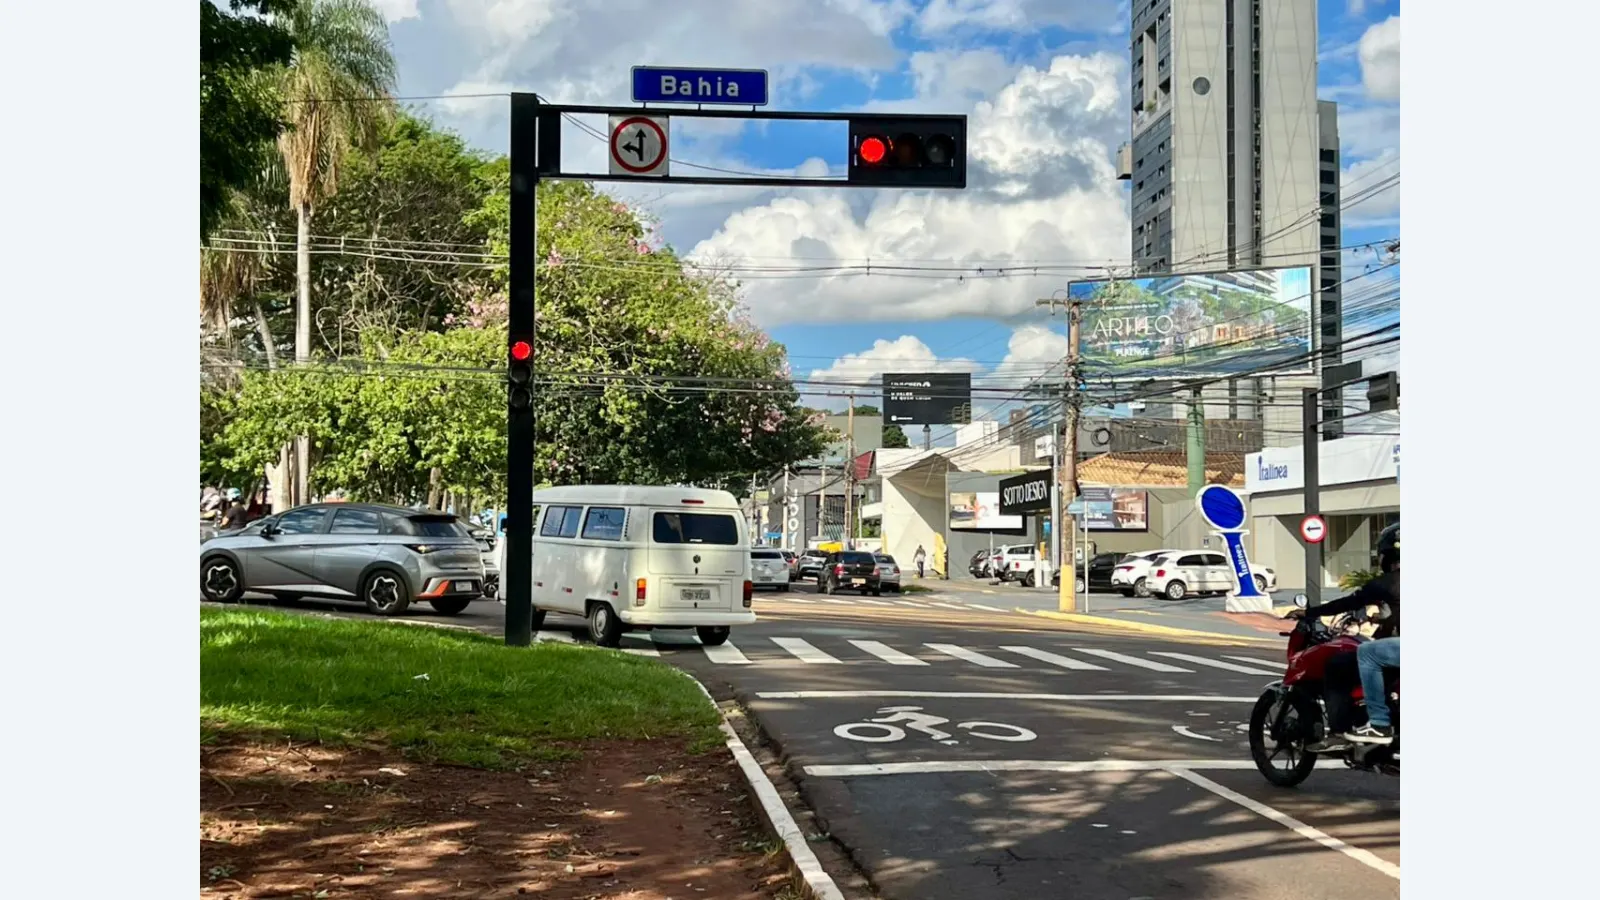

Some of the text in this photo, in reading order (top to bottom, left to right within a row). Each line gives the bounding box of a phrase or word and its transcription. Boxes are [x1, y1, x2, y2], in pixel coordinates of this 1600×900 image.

[661, 75, 739, 97] Bahia
[1003, 480, 1047, 506] SOTTO DESIGN
